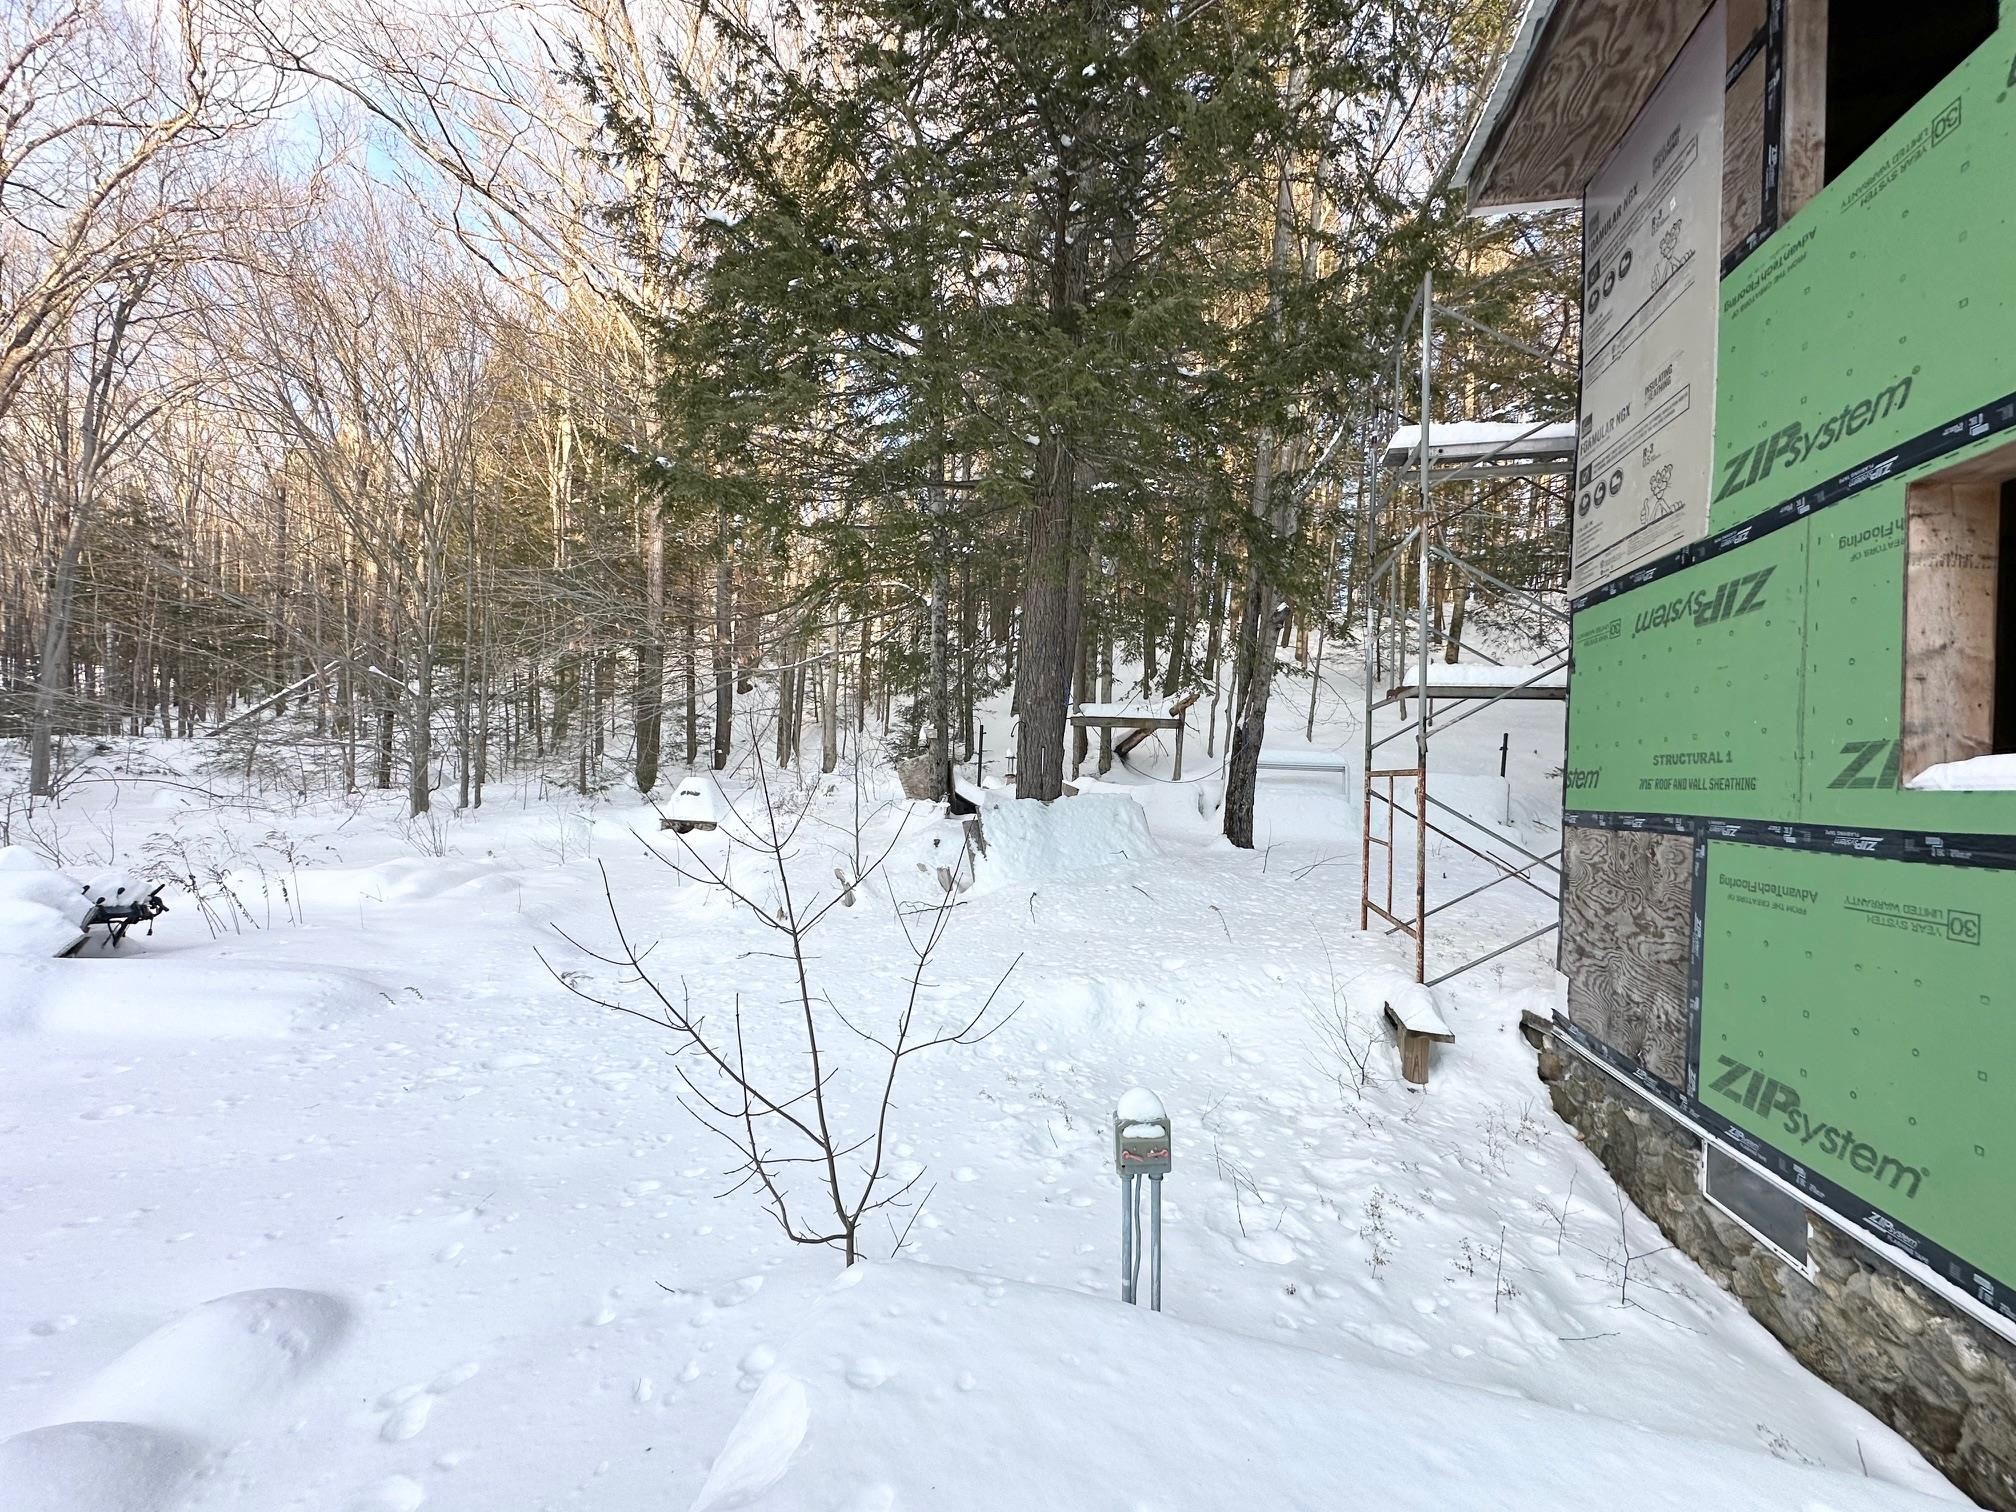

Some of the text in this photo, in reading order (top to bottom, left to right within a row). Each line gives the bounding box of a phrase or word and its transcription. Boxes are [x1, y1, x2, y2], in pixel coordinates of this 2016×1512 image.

[1839, 521, 1893, 550] Flooring
[1653, 750, 1733, 766] STRUCTURAL 1
[1654, 779, 1673, 790] ROOF
[1673, 779, 1688, 790] AND
[1708, 777, 1757, 791] SHEATHING
[1846, 895, 1943, 919] LIMITED WARRANTY
[1866, 914, 1942, 937] YEAR SYSTEM
[1950, 917, 1977, 938] 30
